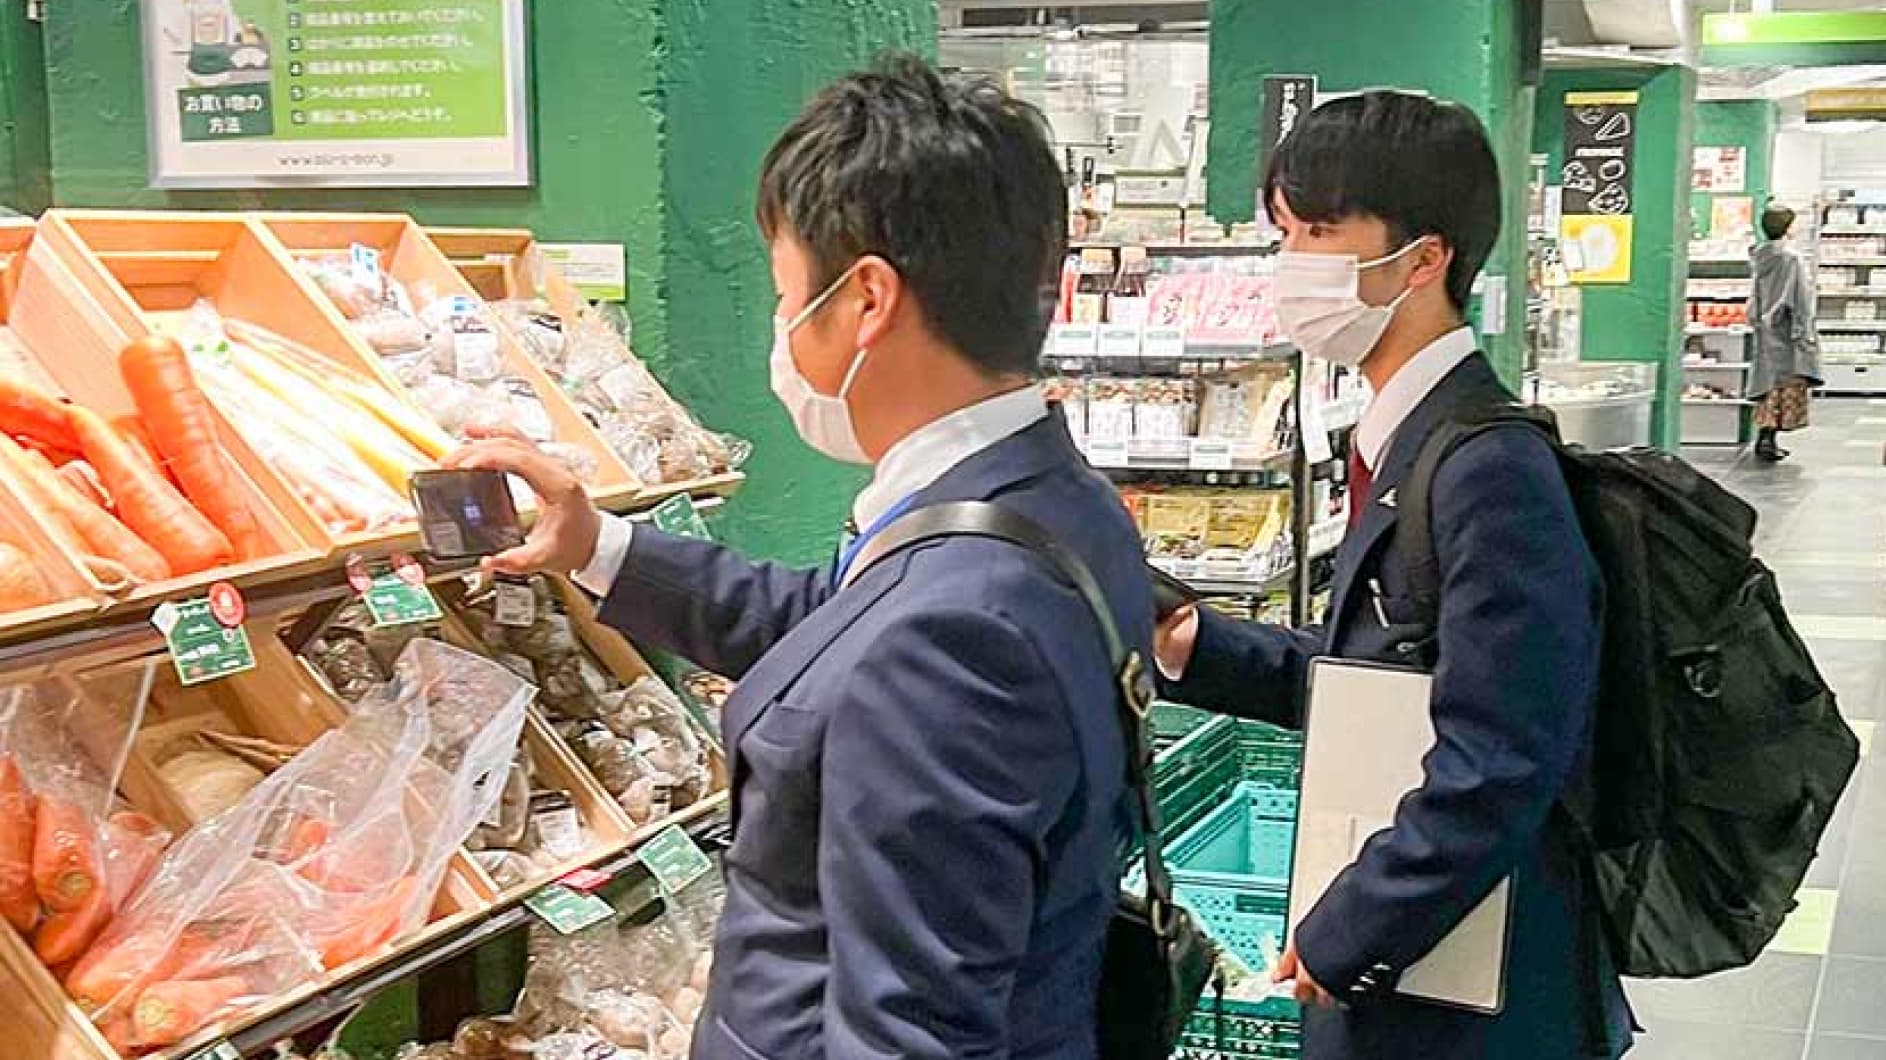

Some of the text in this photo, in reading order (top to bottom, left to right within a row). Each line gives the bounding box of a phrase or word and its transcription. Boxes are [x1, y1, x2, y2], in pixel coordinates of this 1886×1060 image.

[183, 94, 264, 113] お買い物の
